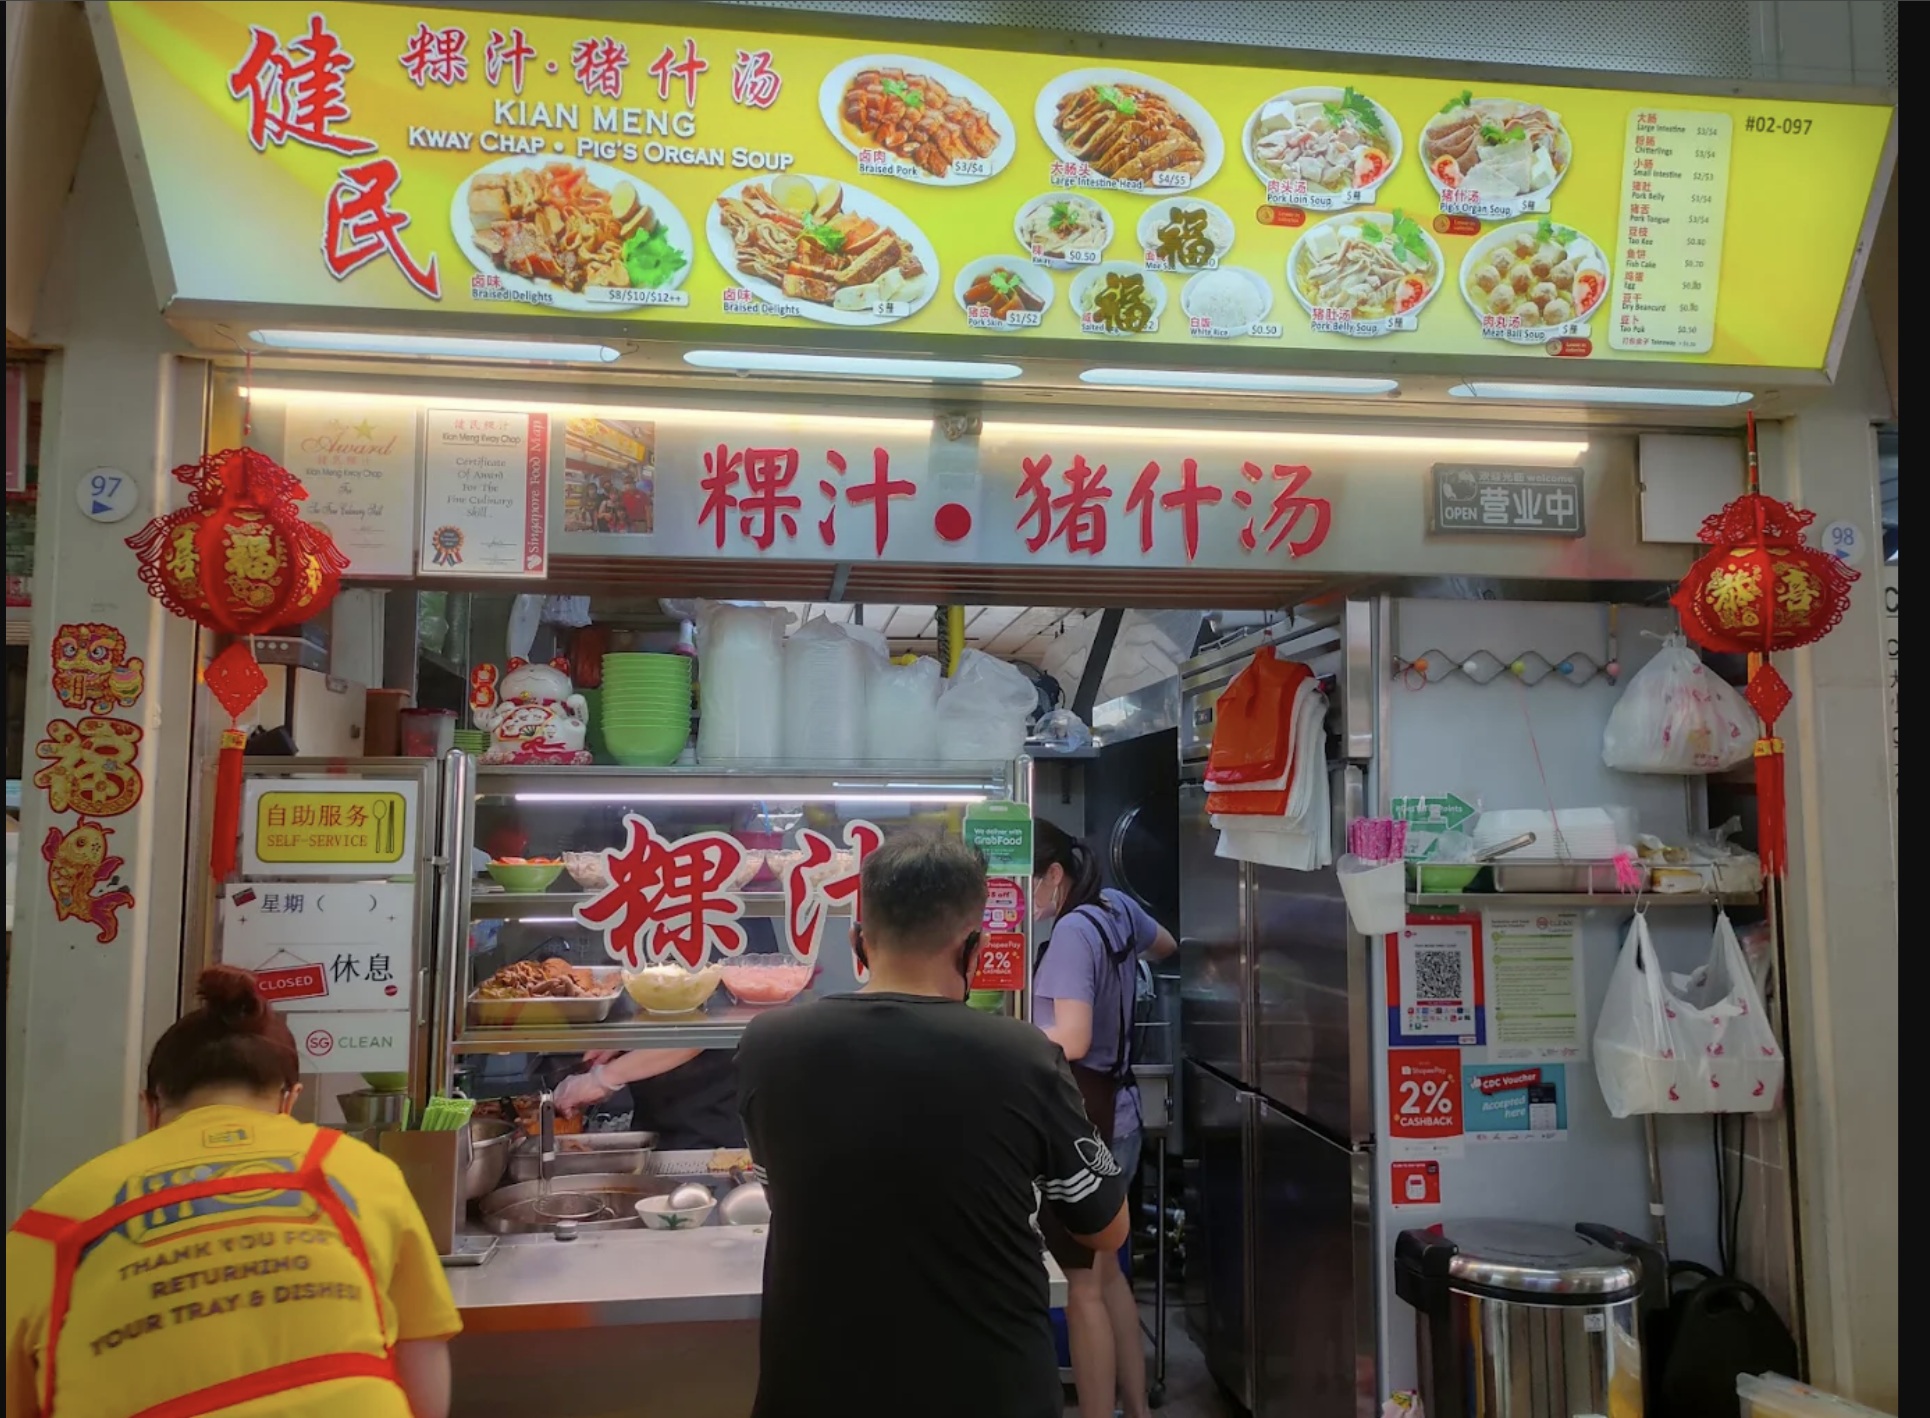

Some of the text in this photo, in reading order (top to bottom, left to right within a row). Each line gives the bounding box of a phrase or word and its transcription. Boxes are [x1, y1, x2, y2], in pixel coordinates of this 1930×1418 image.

[494, 99, 696, 138] KIAN MENG
[1637, 124, 1655, 132] Large
[1656, 125, 1686, 133] Intestine
[1745, 116, 1813, 135] #02-097
[408, 126, 794, 170] KWAY CHAP PIG'S ORGAN SOUP
[859, 163, 918, 176] Braised Pork
[955, 161, 984, 173] $3/$4
[1050, 162, 1090, 177] 大肠头
[1158, 174, 1186, 185] $4/$5
[1653, 170, 1682, 178] Intestine
[1050, 177, 1142, 189] Large Intestine Head
[1267, 194, 1331, 206] Pork Loin Soup
[1632, 192, 1646, 200] Pork
[1648, 192, 1665, 202] Belly
[1440, 202, 1511, 216] Pig's Organ Soup
[1647, 215, 1670, 224] Tongue
[1069, 250, 1096, 261] $0.50
[1626, 260, 1639, 268] Fish
[1641, 260, 1656, 268] Cake
[472, 273, 501, 288] 卤味
[1624, 282, 1636, 290] Egg
[472, 288, 553, 304] Braised Delights
[608, 290, 681, 303] $8/$10/$12++
[723, 287, 752, 301] 卤味
[723, 302, 799, 317] Braised Delights
[1622, 303, 1666, 312] Dry Beancurd
[968, 319, 1003, 327] Pork Skin
[1009, 312, 1038, 324] $1/$2
[1190, 317, 1211, 328] 白饭
[1483, 316, 1520, 329] 肉丸汤
[1082, 322, 1105, 331] Salted
[1190, 328, 1212, 336] White
[1252, 325, 1277, 335] $0.50
[1311, 321, 1377, 333] Pork Belly Soup
[1482, 329, 1546, 340] Meat Ball Soup
[302, 432, 398, 456] Award
[442, 433, 457, 441] Kian
[459, 434, 479, 443] Meng
[501, 435, 521, 444] Chap
[456, 457, 506, 469] Certificate
[322, 469, 342, 478] Meng
[457, 469, 503, 480] Of Award
[1527, 474, 1573, 483] welcome
[91, 475, 122, 497] 97
[528, 420, 546, 553] Singapore Food Map
[447, 495, 513, 508] Fine Culinary
[1480, 486, 1573, 526] 营业中
[1445, 506, 1477, 520] OPEN
[1832, 527, 1854, 546] 98
[267, 803, 369, 828] 自助服务
[267, 834, 368, 847] SELF-SERVICE
[974, 836, 1022, 845] GrabFood
[983, 952, 1011, 968] 2%
[330, 953, 394, 983] 休息
[259, 974, 313, 991] CLOSED
[309, 1036, 393, 1049] SG CLEAN
[1412, 1066, 1446, 1076] ShopeePay
[1482, 1073, 1536, 1089] CDC Voucher
[1400, 1080, 1453, 1114] 2%
[1482, 1096, 1526, 1111] Accepted
[1504, 1107, 1526, 1118] here
[1399, 1116, 1453, 1127] CASHBACK
[119, 1241, 212, 1281] THANK
[221, 1230, 275, 1252] YOU
[152, 1254, 310, 1299] RETURNING
[89, 1312, 164, 1357] YOUR
[169, 1293, 240, 1325] TRAY
[249, 1289, 265, 1308] &
